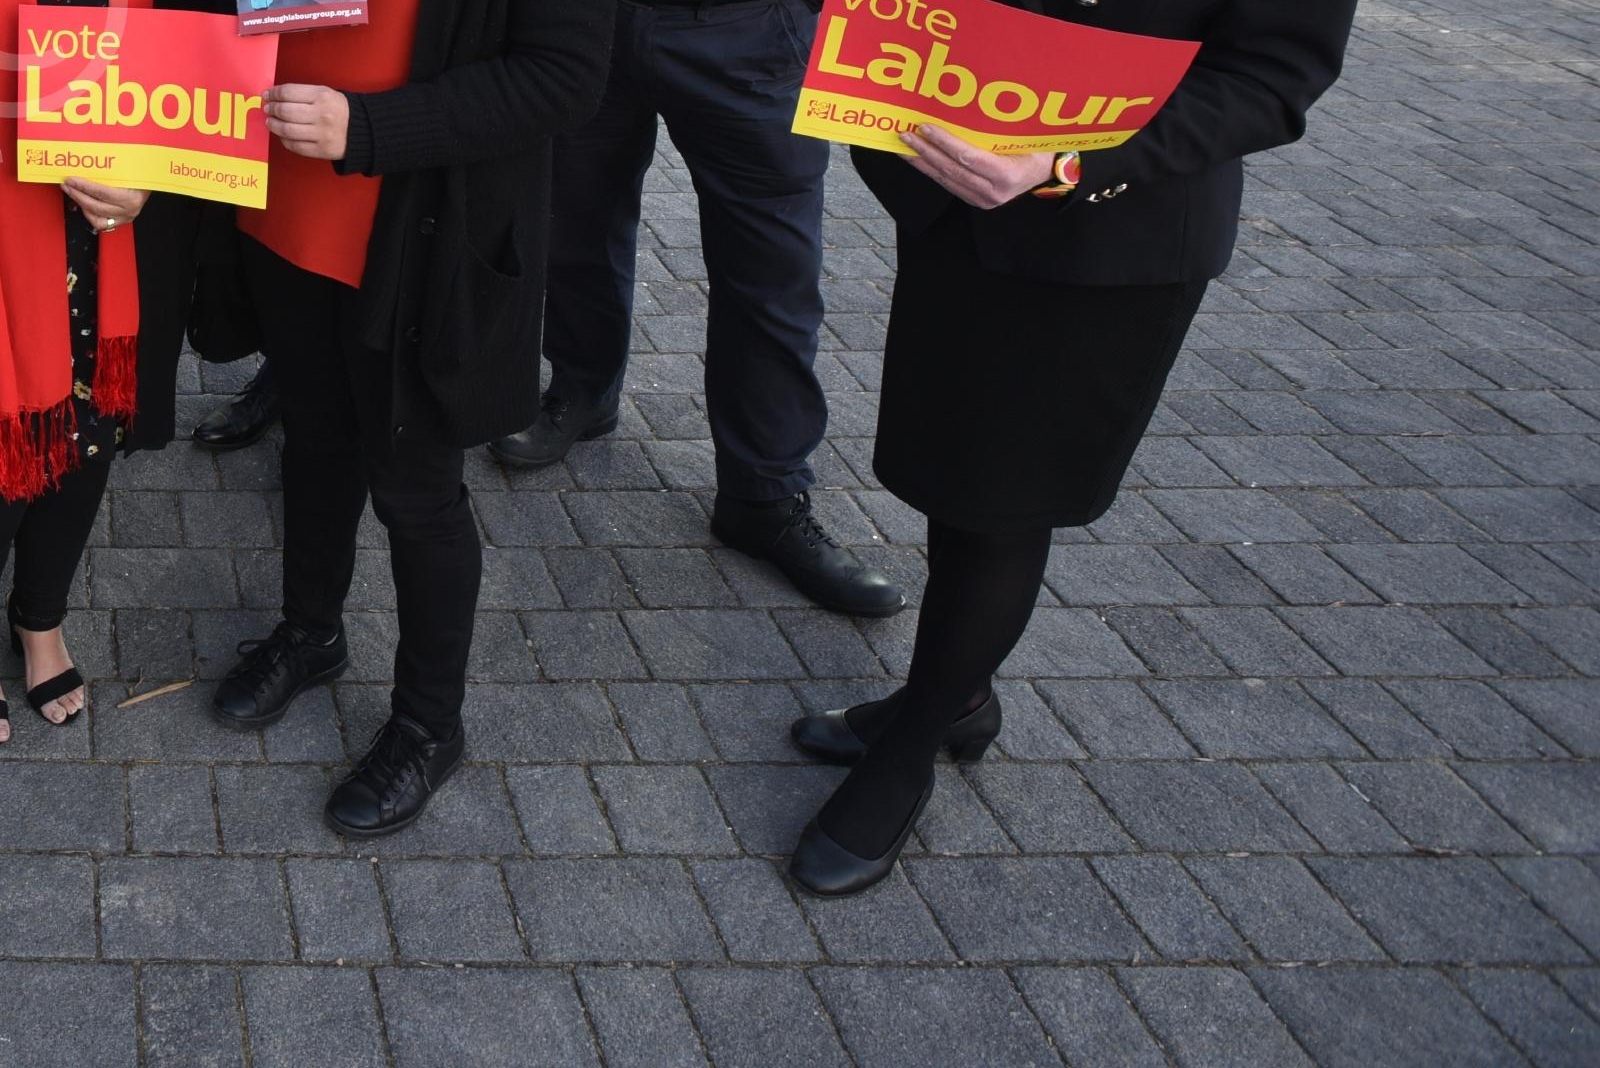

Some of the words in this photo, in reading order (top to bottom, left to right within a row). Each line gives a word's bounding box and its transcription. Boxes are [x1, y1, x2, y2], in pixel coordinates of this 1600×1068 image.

[27, 25, 120, 60] vote
[817, 16, 1154, 126] Labour
[26, 65, 262, 139] Labour
[44, 151, 116, 169] Labour
[170, 161, 257, 188] labour.org.uk
